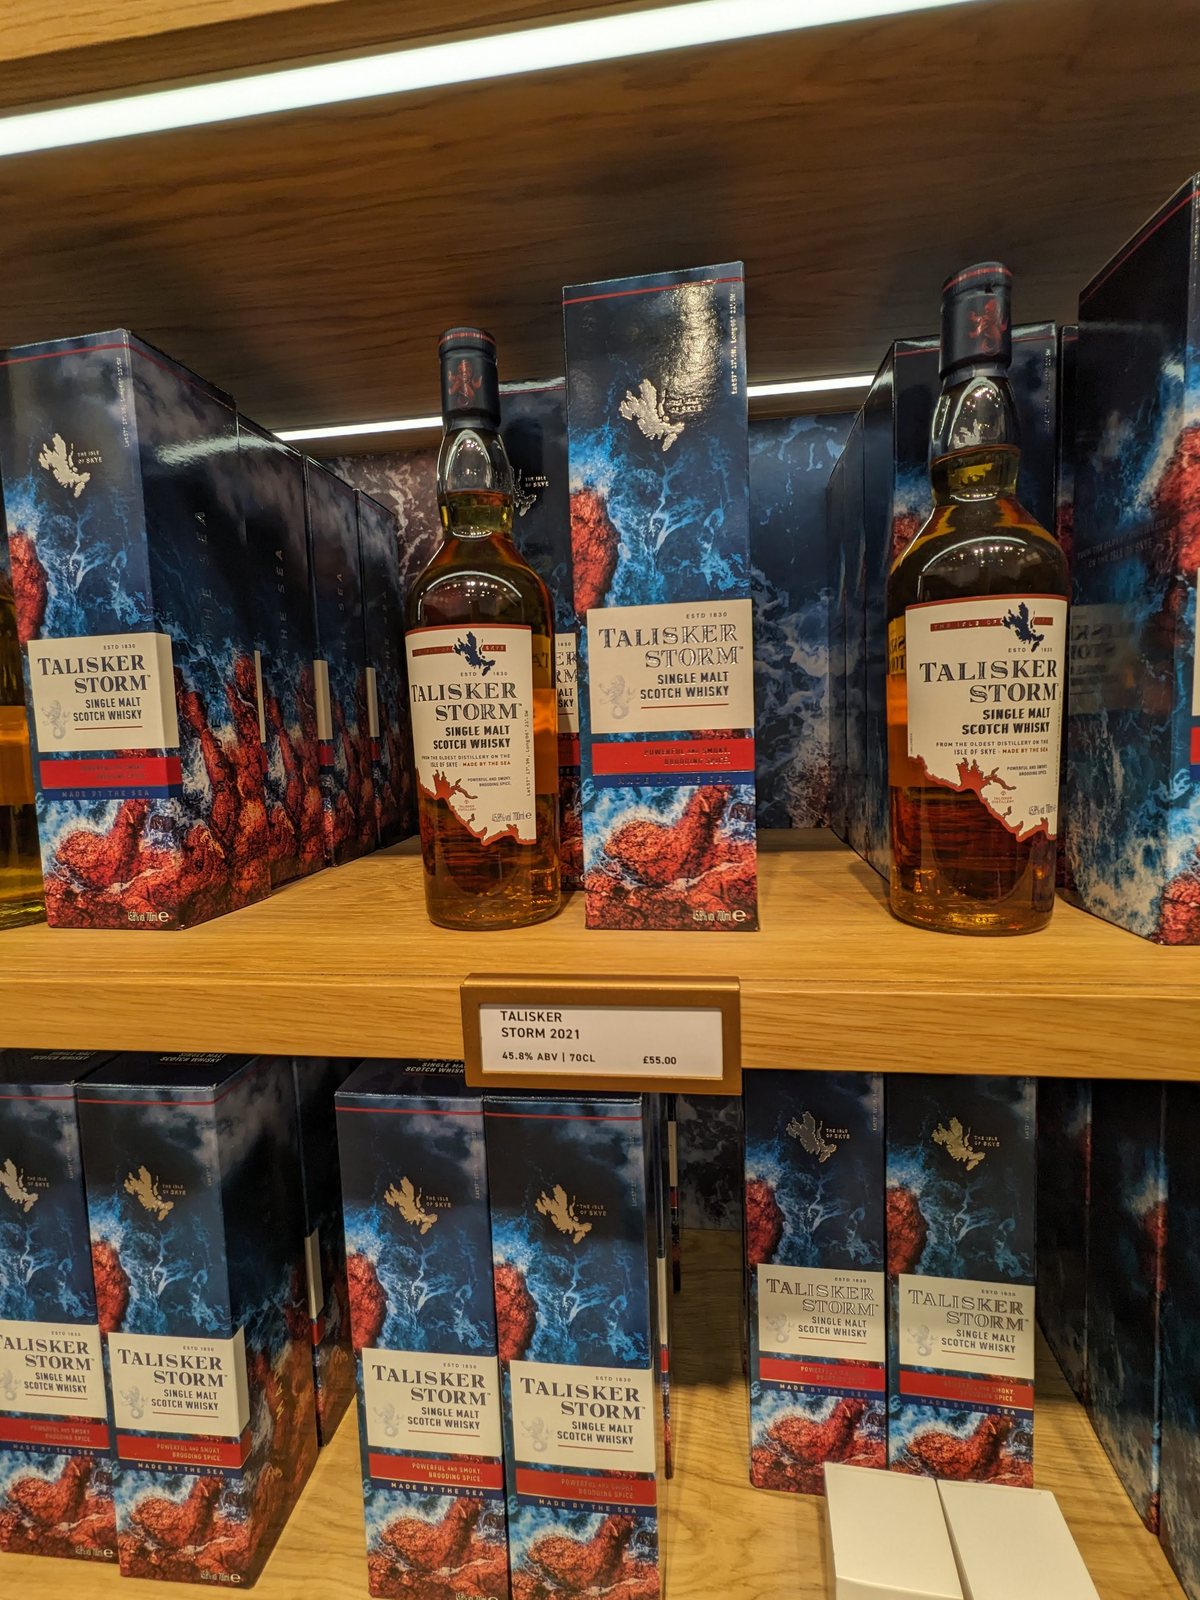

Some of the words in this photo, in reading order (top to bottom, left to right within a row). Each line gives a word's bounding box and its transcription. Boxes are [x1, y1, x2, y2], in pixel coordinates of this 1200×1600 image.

[598, 624, 738, 648] TALISKER
[38, 654, 146, 676] TALISKER
[919, 660, 1057, 683] TALISKER
[657, 673, 696, 685] SINGLE
[700, 671, 729, 683] MALT
[411, 682, 518, 702] TALISKER
[640, 688, 681, 700] SCOTCH
[686, 685, 729, 698] WHISKY
[85, 698, 116, 709] SINGLE
[119, 697, 141, 707] MALT
[73, 711, 105, 722] SCOTCH
[108, 709, 142, 720] WHISKY
[982, 708, 1025, 720] SINGLE
[1028, 707, 1051, 718] MALT
[445, 726, 480, 737] SINGLE
[483, 725, 510, 736] MALT
[961, 724, 1009, 735] SCOTCH
[1012, 721, 1050, 733] WHISKY
[433, 740, 467, 750] SCOTCH
[470, 738, 511, 749] WHISKY
[500, 1010, 562, 1023] TALISKER
[501, 1027, 546, 1039] STORM
[550, 1029, 580, 1040] 2021
[502, 1051, 533, 1061] 45.8%
[537, 1052, 558, 1062] ABV
[569, 1053, 596, 1063] 70CL
[643, 1055, 677, 1065] £55.00
[766, 1278, 874, 1301] TALISKER
[908, 1289, 1024, 1315] TALISKER
[811, 1316, 841, 1326] SINGLE
[844, 1319, 867, 1328] MALT
[798, 1324, 830, 1334] SCOTCH
[833, 1327, 867, 1337] WHISKY
[956, 1329, 988, 1340] SINGLE
[992, 1334, 1016, 1343] MALT
[0, 1334, 90, 1355] ALISKER
[941, 1338, 976, 1349] SCOTCH
[979, 1341, 1016, 1353] WHISKY
[117, 1348, 223, 1371] TALISKER
[35, 1372, 63, 1382] SINGLE
[65, 1374, 86, 1384] MALT
[371, 1364, 486, 1389] TALISKER
[24, 1381, 54, 1391] SCOTCH
[56, 1383, 87, 1393] WHISKY
[519, 1377, 640, 1402] TALISKER
[780, 1383, 804, 1391] MADE
[163, 1389, 193, 1399] SINGLE
[196, 1390, 217, 1400] MALT
[151, 1398, 183, 1409] SCOTCH
[185, 1400, 219, 1411] WHISKY
[997, 1407, 1016, 1415] SEA
[421, 1406, 454, 1417] SINGLE
[456, 1409, 480, 1419] MALT
[407, 1416, 441, 1427] SCOTCH
[444, 1419, 480, 1430] WHISKY
[572, 1421, 605, 1432] SINGLE
[608, 1424, 633, 1434] MALT
[557, 1431, 593, 1442] SCOTCH
[596, 1434, 634, 1445] WHISKY
[156, 1443, 188, 1452] POWERFUL
[172, 1452, 201, 1460] BROODING
[184, 1466, 201, 1474] THE
[411, 1462, 445, 1471] POWERFUL
[428, 1472, 460, 1480] BROODING
[391, 1482, 417, 1490] MADE
[538, 1499, 566, 1508] MADE
[617, 1506, 637, 1514] SEA
